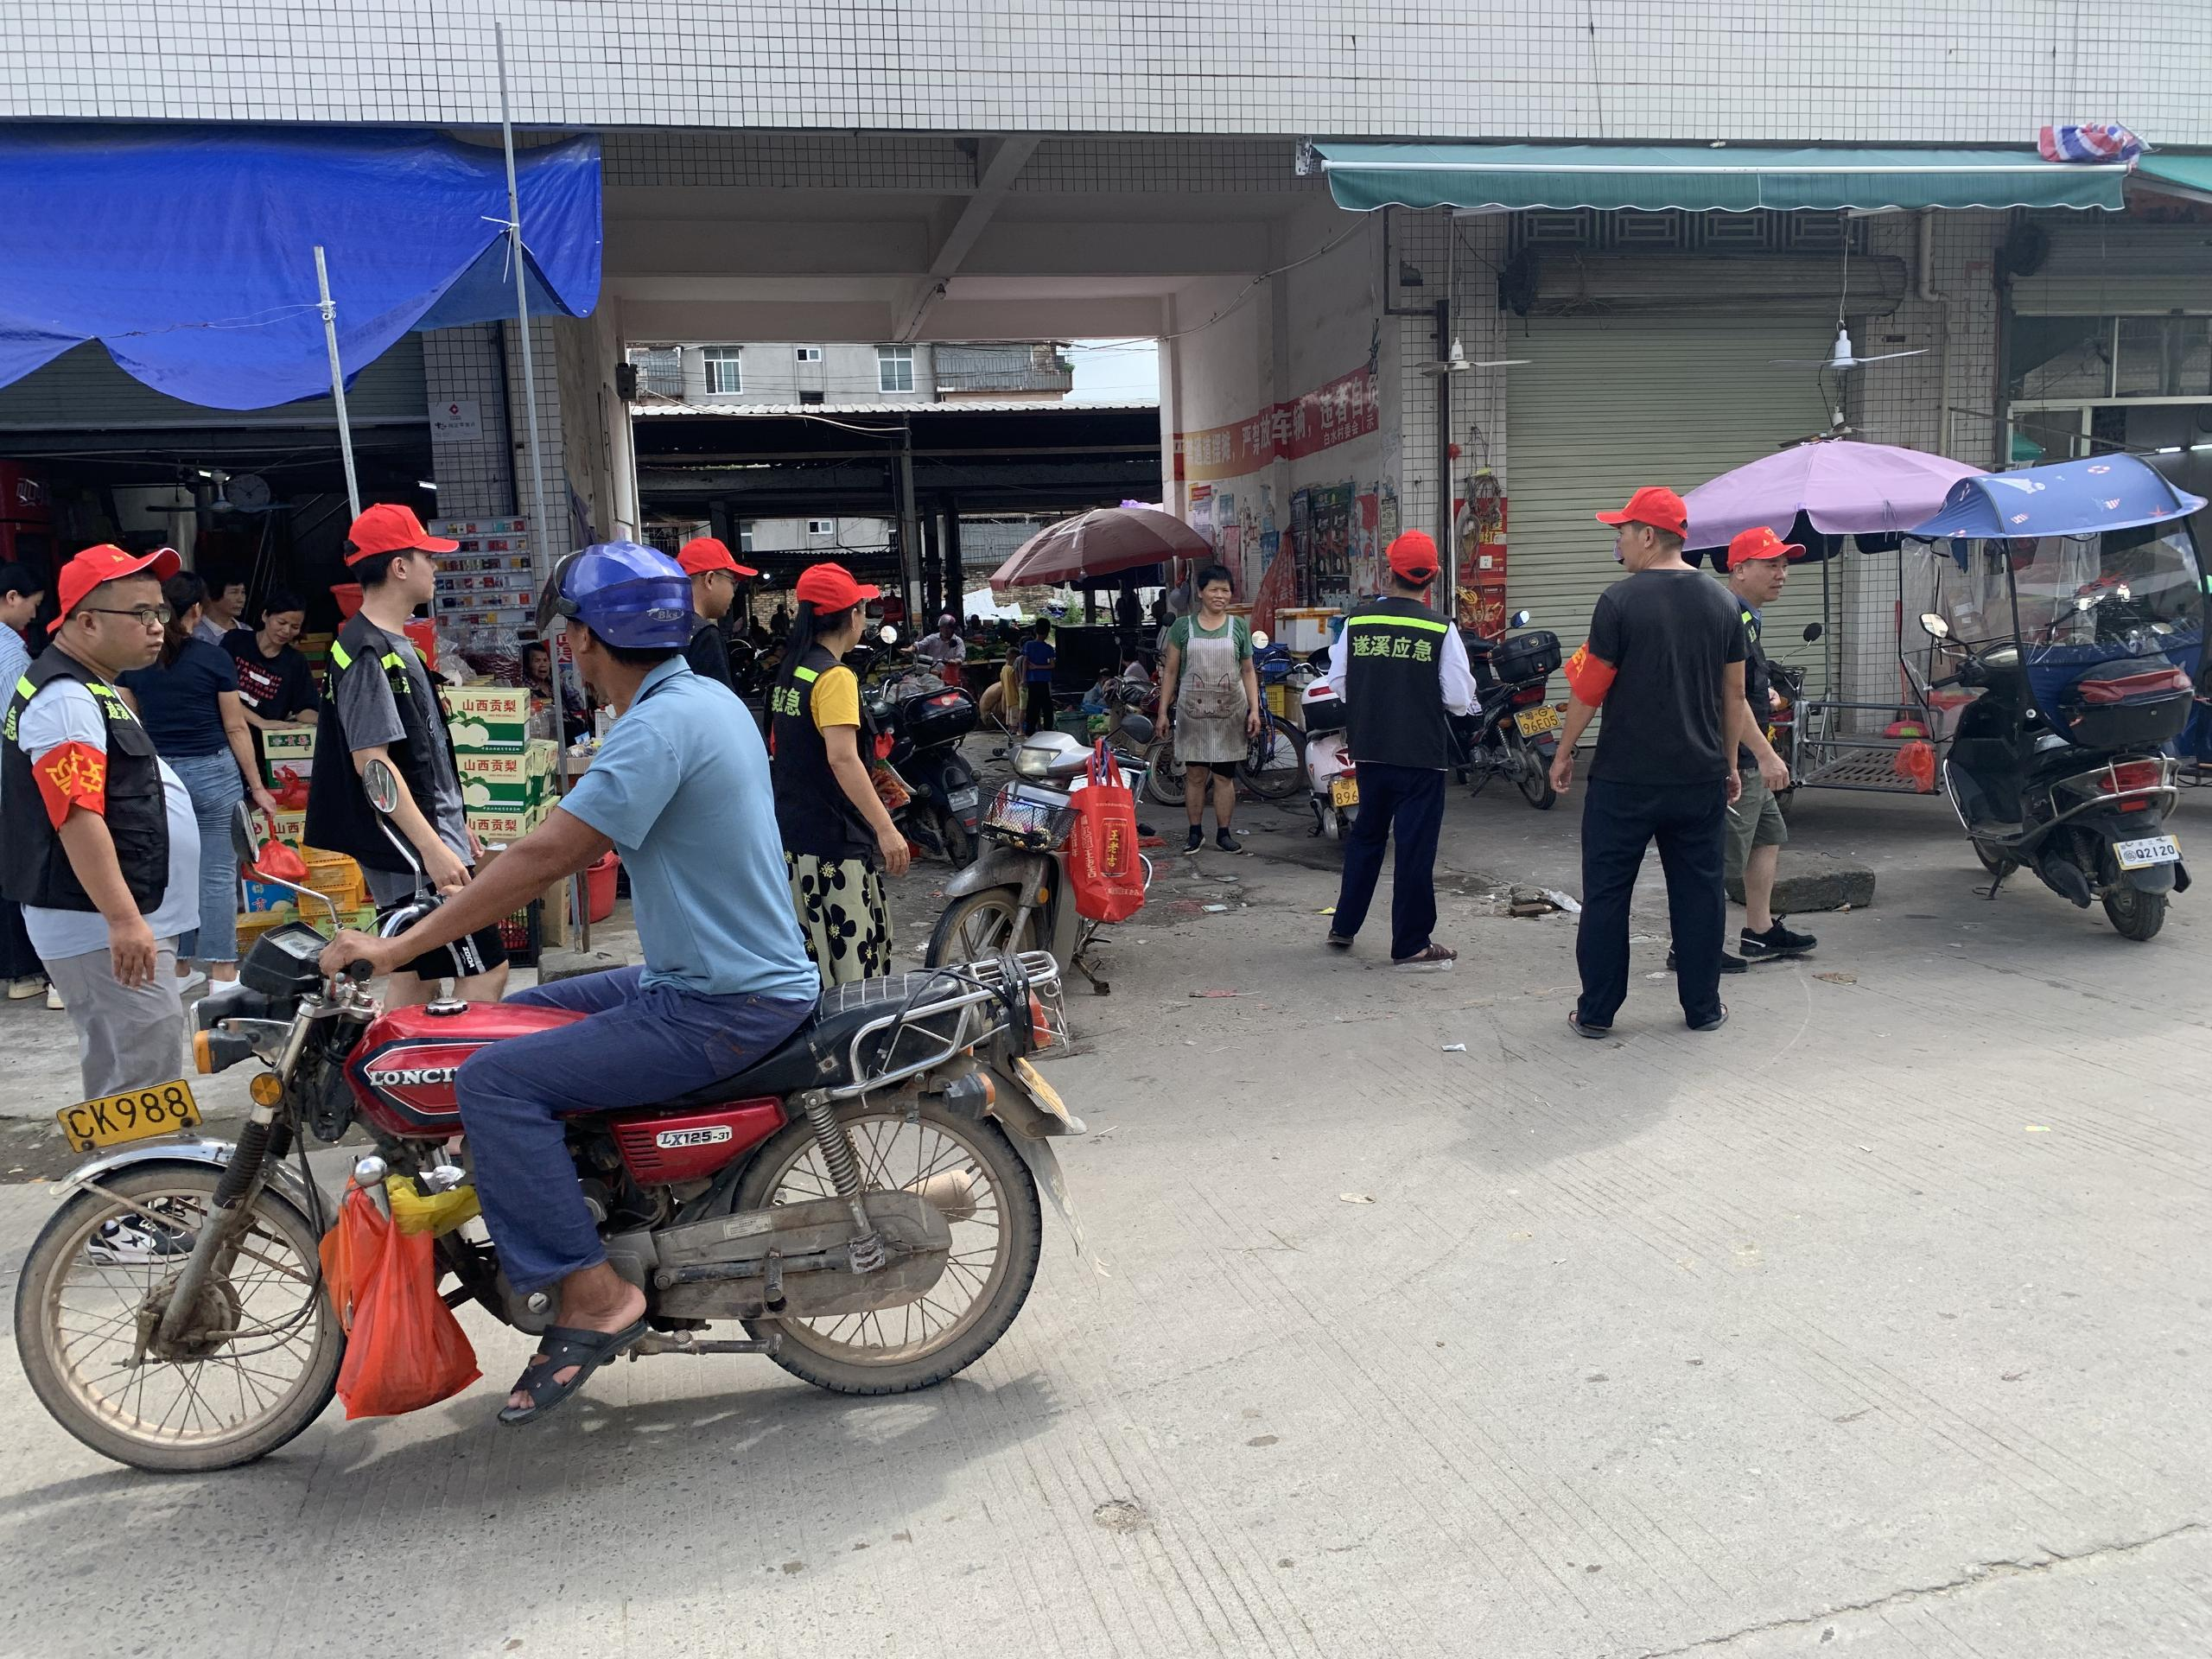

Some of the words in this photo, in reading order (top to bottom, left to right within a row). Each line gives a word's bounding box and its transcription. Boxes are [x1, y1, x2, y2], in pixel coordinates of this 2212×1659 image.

[1352, 635, 1433, 662] 遂溪应急
[462, 698, 518, 713] 山西贡梨
[1522, 715, 1559, 734] 96E05
[45, 749, 105, 797] 安员
[463, 759, 518, 772] 山西贡梨
[467, 818, 518, 831] 山西贡梨
[1107, 830, 1119, 868] 王老吉
[2135, 844, 2176, 860] Q2120
[370, 1067, 458, 1086] LONCI
[67, 1086, 189, 1139] CK988
[660, 1130, 730, 1147] LX125-31
